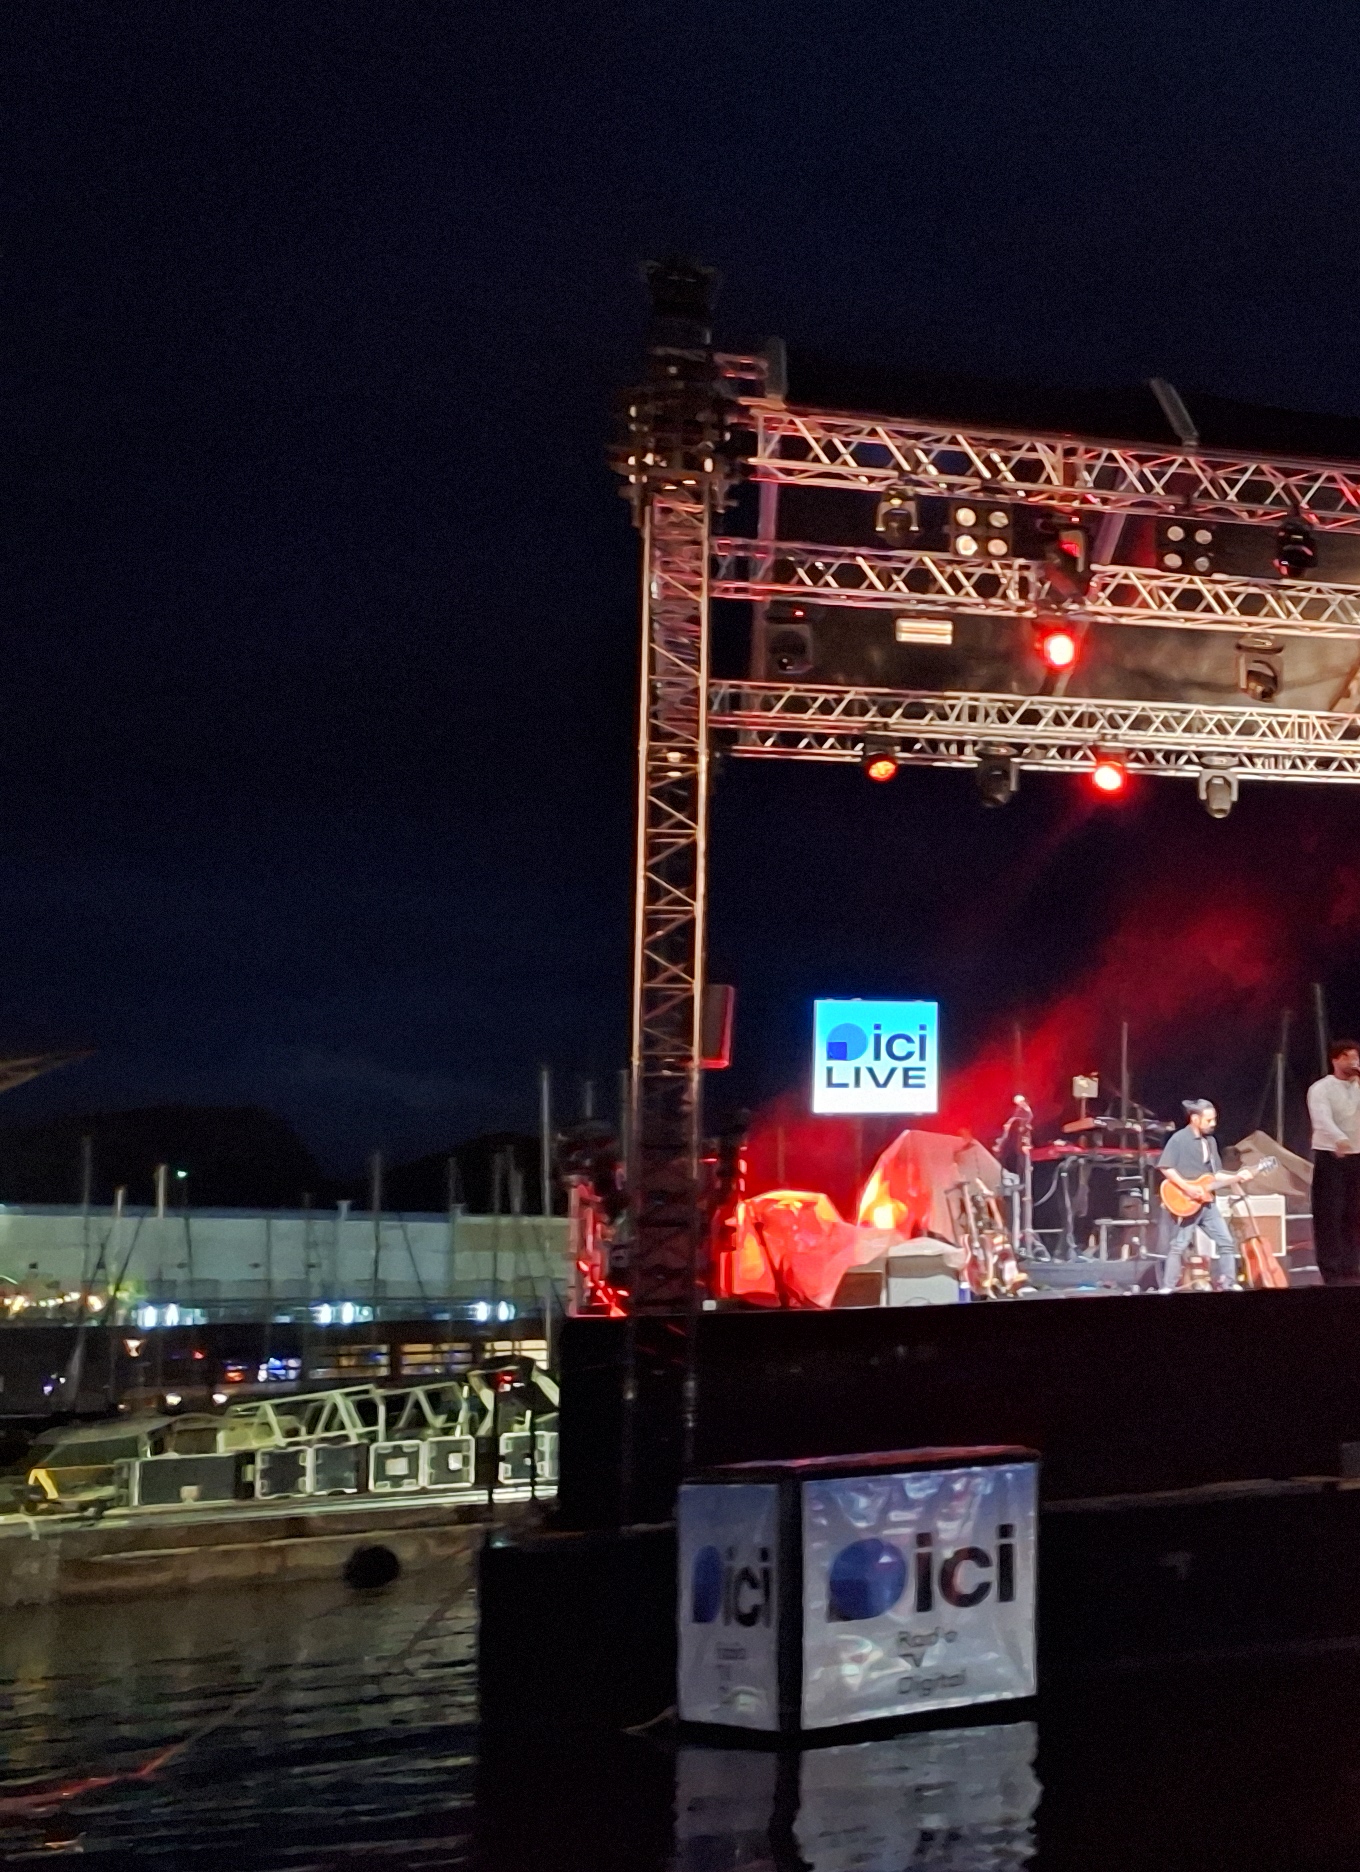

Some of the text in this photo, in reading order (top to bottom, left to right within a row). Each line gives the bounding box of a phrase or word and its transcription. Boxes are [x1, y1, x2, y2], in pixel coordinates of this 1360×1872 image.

[873, 1023, 927, 1062] ici
[825, 1066, 927, 1089] LIVE
[722, 1547, 772, 1628] ici
[915, 1523, 1015, 1613] ici
